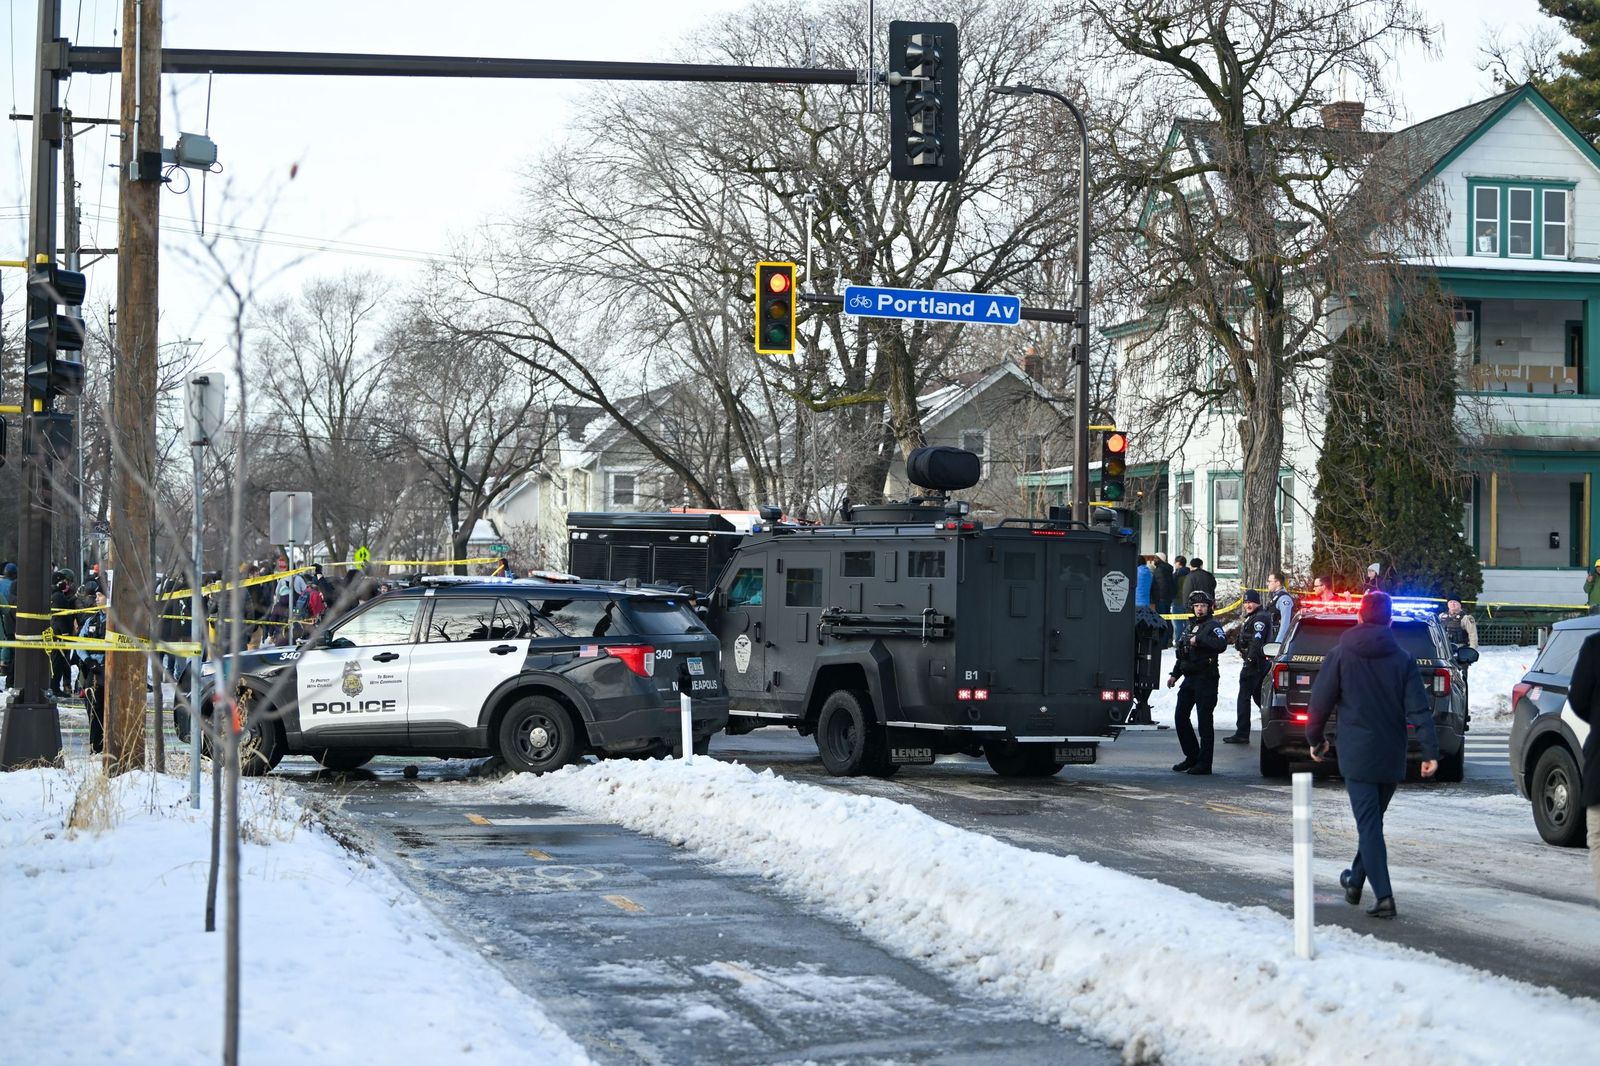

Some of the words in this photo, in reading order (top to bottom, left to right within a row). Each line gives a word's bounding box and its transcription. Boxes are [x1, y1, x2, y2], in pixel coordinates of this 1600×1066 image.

[877, 294, 974, 316] Portland
[986, 301, 1014, 319] Av
[279, 652, 301, 661] 340
[655, 649, 672, 660] 340
[1291, 654, 1327, 662] SHERIFF
[965, 670, 978, 680] B1
[672, 680, 718, 691] MEAPOLIS
[312, 700, 396, 714] POLICE
[891, 747, 932, 757] LENCO
[1055, 747, 1093, 757] LENCO
